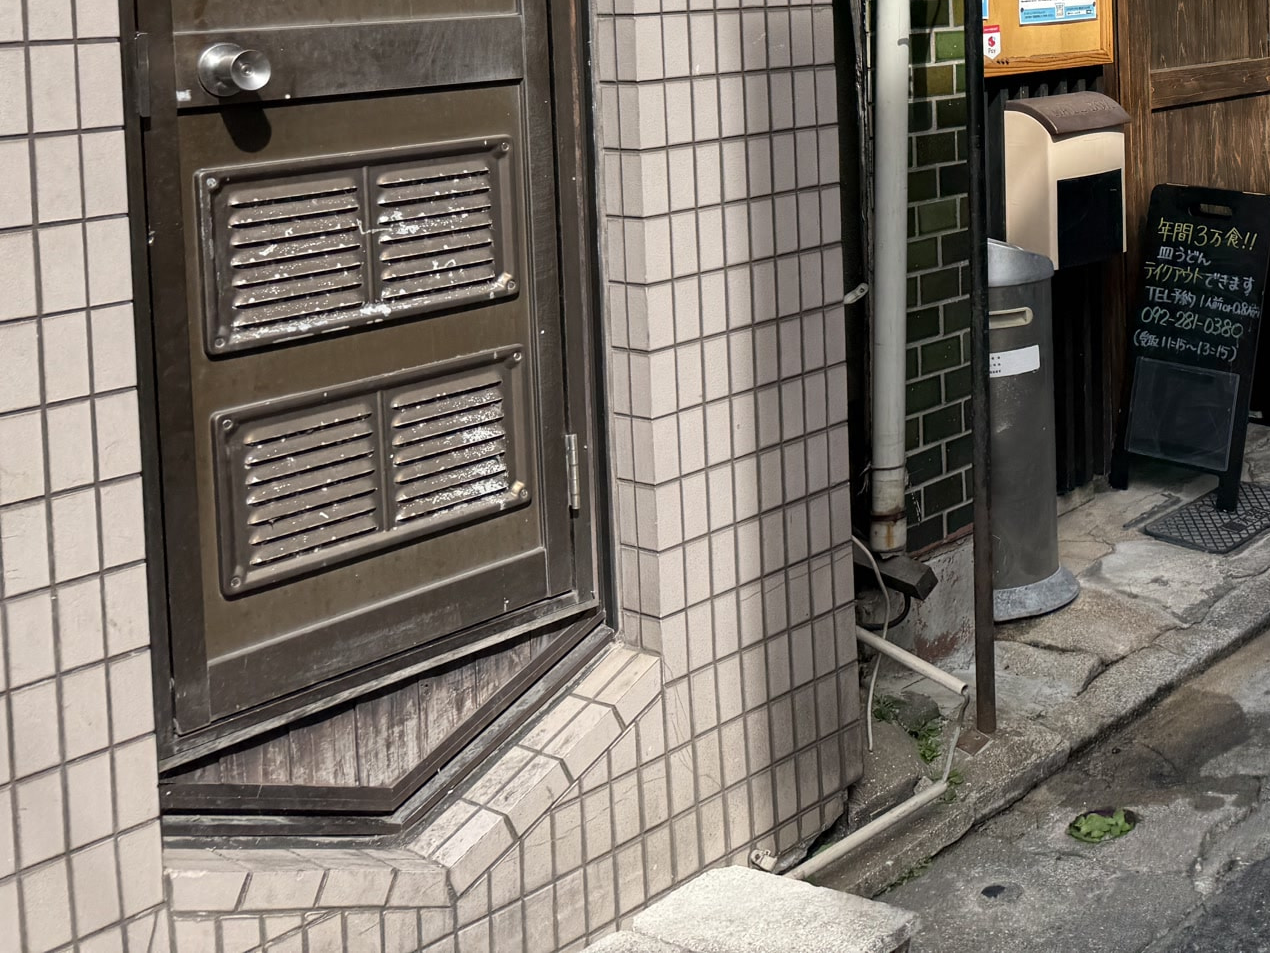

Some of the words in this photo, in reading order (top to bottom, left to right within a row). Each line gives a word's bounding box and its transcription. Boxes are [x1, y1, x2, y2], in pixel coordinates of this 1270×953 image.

[1157, 246, 1212, 266] 皿うどん
[1144, 261, 1255, 297] テイクアウトできます
[1145, 286, 1197, 307] TEL予約
[1141, 306, 1244, 339] 092-281-0380
